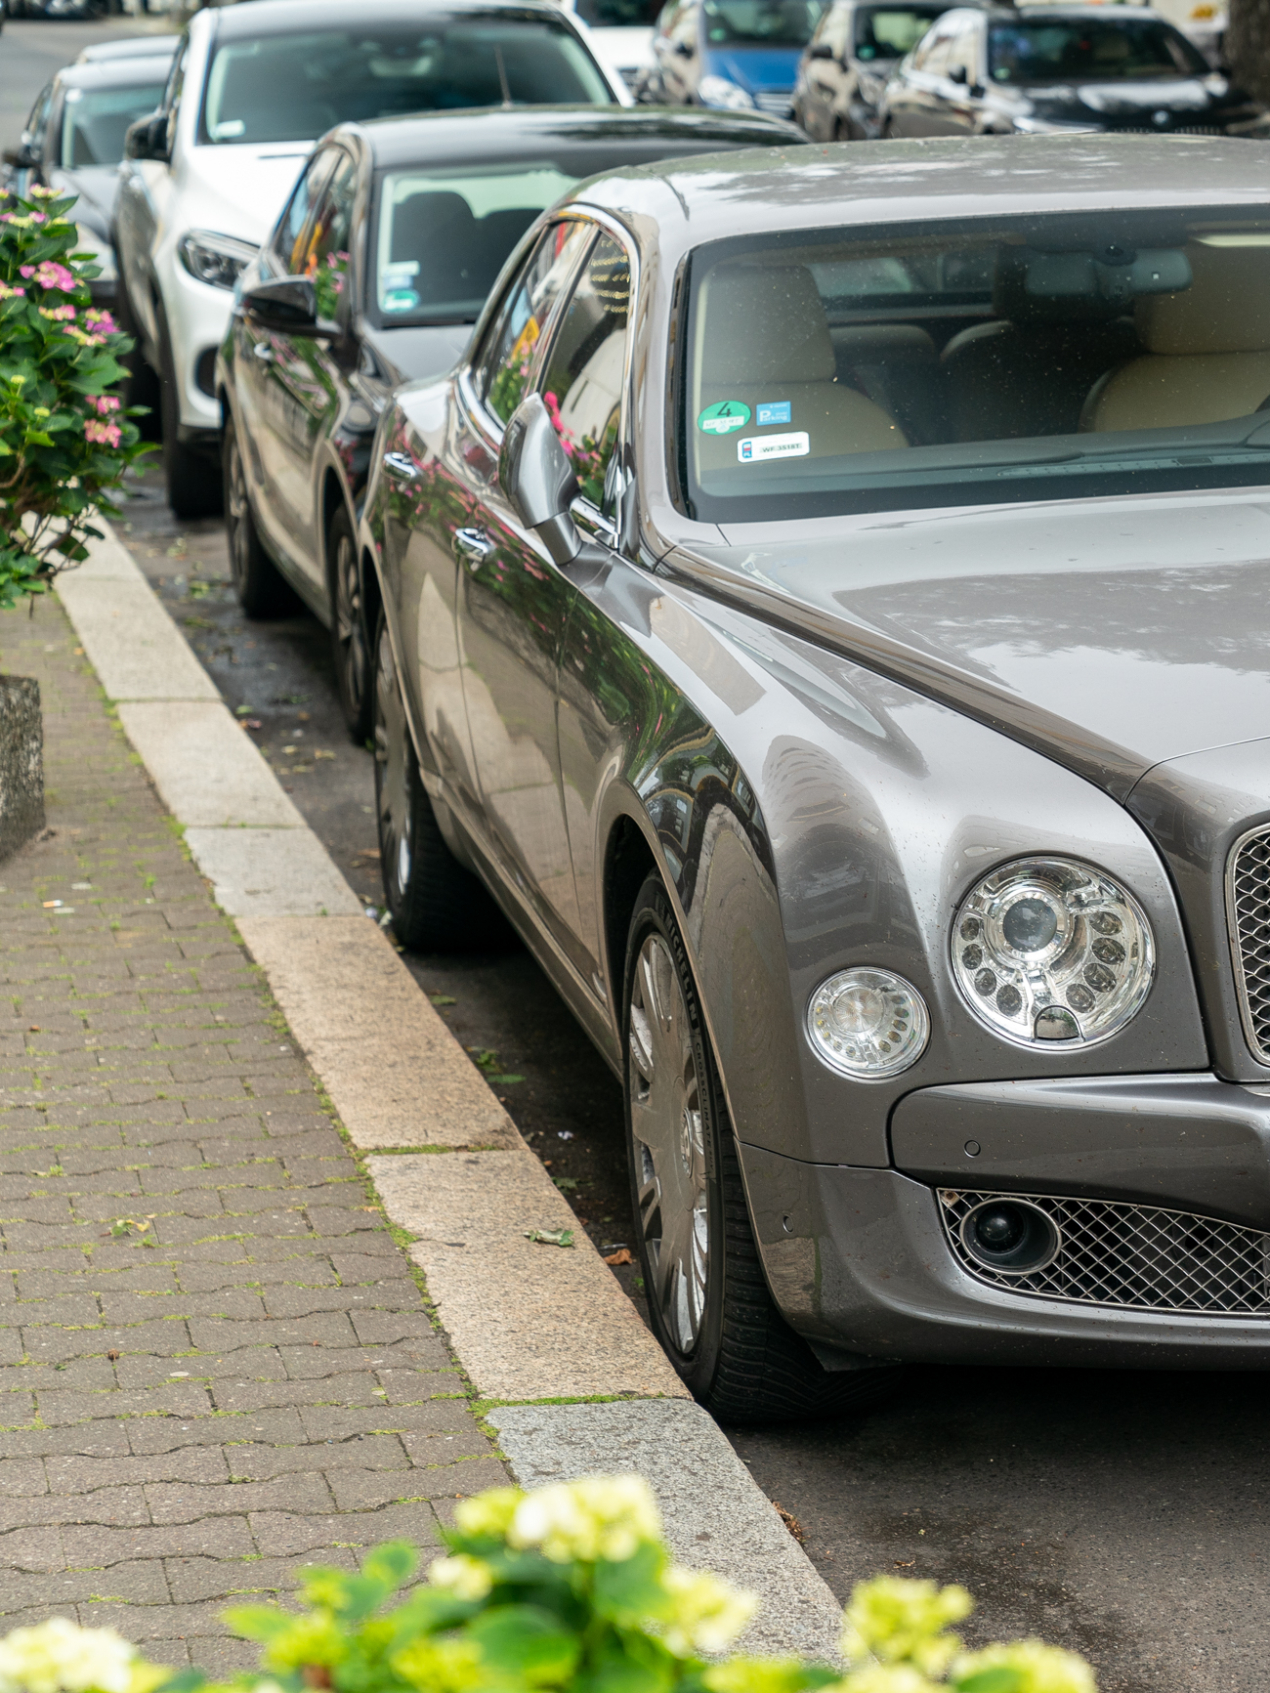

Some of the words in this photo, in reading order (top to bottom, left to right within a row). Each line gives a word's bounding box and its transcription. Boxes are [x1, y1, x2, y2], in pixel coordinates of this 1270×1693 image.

[717, 402, 732, 417] 4
[759, 410, 788, 423] Parking
[664, 914, 698, 1022] MICHELIN
